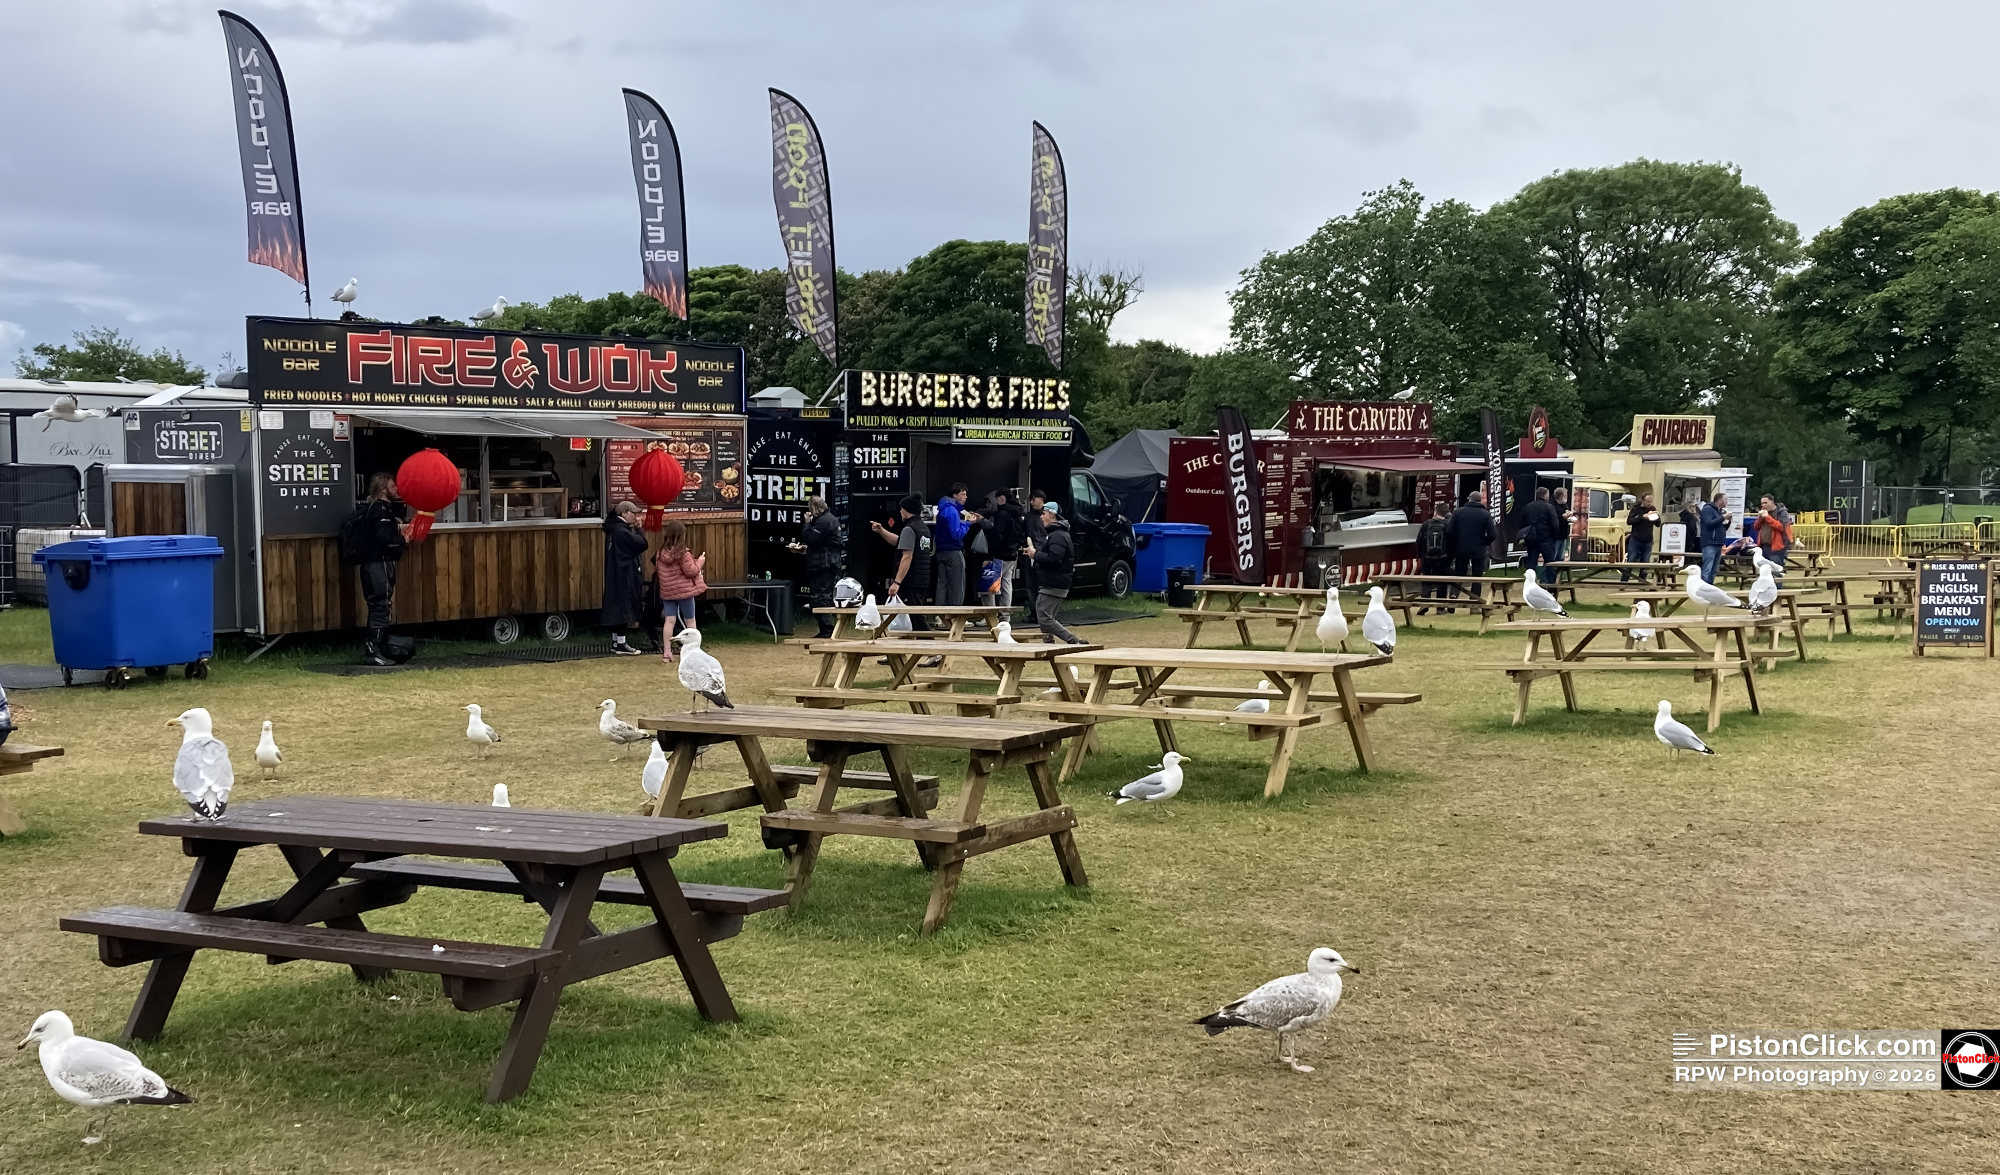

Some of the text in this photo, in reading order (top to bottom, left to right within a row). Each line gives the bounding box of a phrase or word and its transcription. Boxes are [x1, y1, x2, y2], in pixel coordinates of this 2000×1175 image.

[263, 338, 337, 353] NOODLE
[282, 358, 320, 371] BAR
[347, 329, 677, 393] FIRE & WOK
[685, 359, 735, 373] NOODLE
[698, 376, 723, 387] BAR
[861, 370, 1070, 411] BURGERS & FRIES
[264, 389, 735, 412] FRIED NOODLES HOT HONEY CHICKEN SPRING ROLLS SALT & CHILLI CRISPY SHREDDED BEEF CHINESE CURRY
[160, 420, 176, 428] THE
[856, 416, 880, 427] PULLED
[881, 416, 898, 427] PORK
[905, 416, 928, 427] CRISPY
[1312, 406, 1415, 431] THE CARVERY
[965, 429, 987, 439] URBAN
[988, 430, 1021, 439] AMERICAN
[1046, 431, 1063, 440] FOOD
[1642, 418, 1707, 445] CHURROS
[273, 438, 291, 460] PAUSE
[315, 438, 335, 459] ENJOY
[293, 450, 316, 458] THE
[775, 431, 791, 440] EAT
[798, 437, 822, 469] ENJOY
[188, 452, 216, 460] DINER
[769, 454, 797, 465] THE
[1183, 454, 1210, 474] THE
[862, 469, 899, 479] DINER
[280, 487, 331, 497] DINER
[1185, 487, 1225, 496] Outdoor Cate
[1492, 448, 1501, 525] YORKSHIRE
[1227, 430, 1254, 571] BURGERS
[1833, 496, 1859, 509] EXIT
[751, 508, 801, 524] DINE
[1940, 572, 1968, 582] FULL
[1929, 583, 1979, 594] ENGLISH
[1921, 595, 1986, 605] BREAKFAST
[1934, 606, 1971, 616] MENU
[1925, 617, 1980, 627] OPEN NOW
